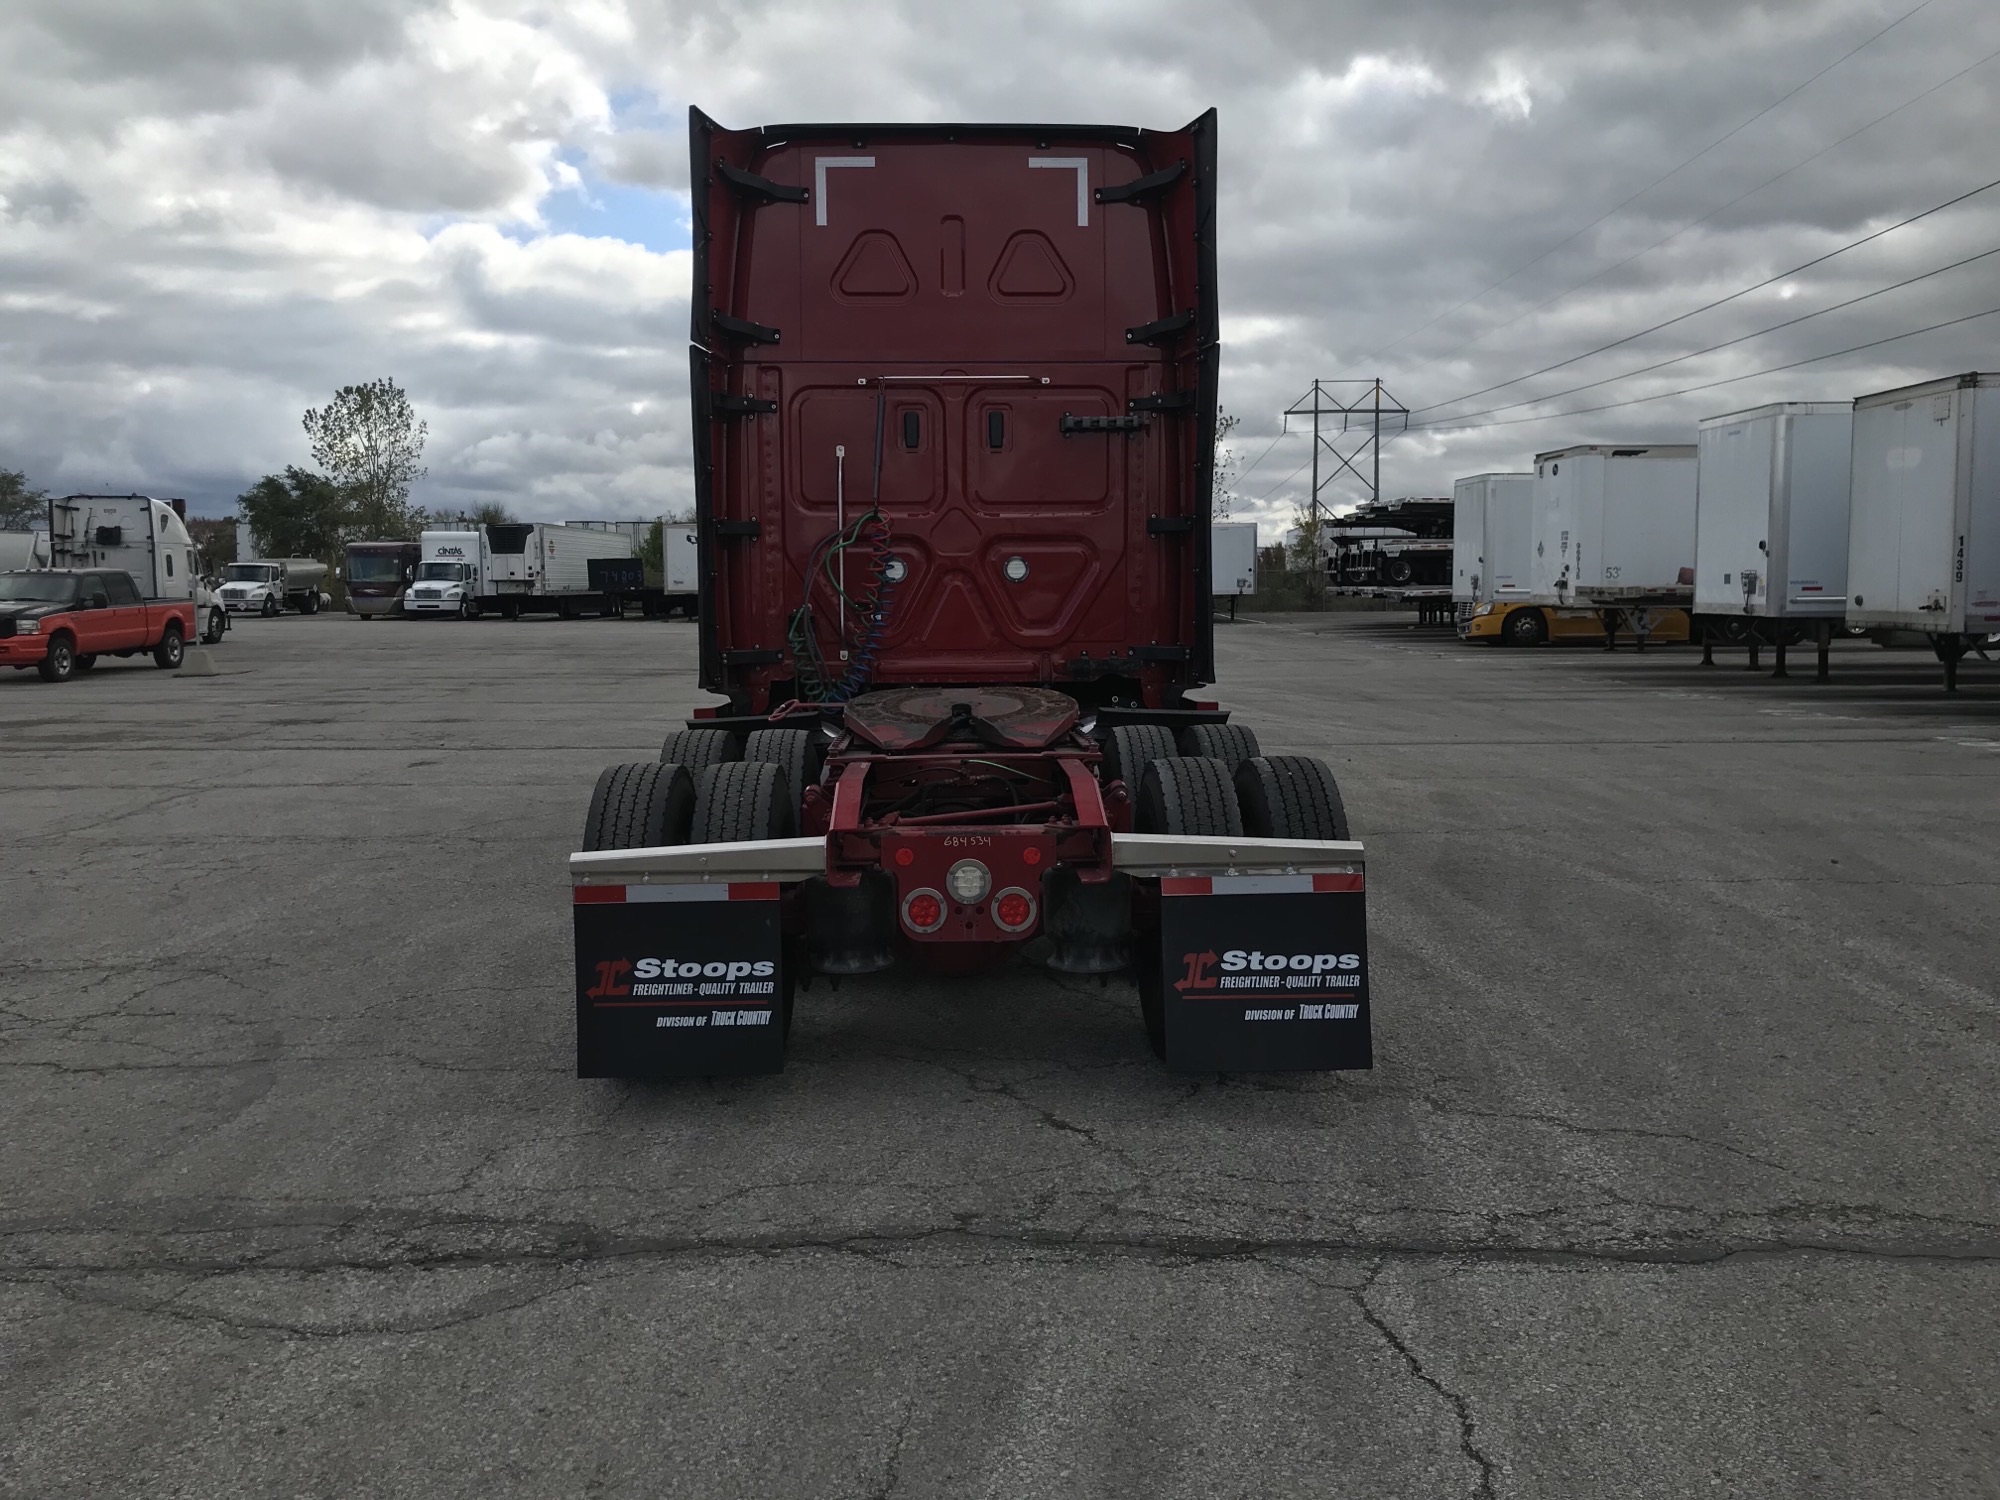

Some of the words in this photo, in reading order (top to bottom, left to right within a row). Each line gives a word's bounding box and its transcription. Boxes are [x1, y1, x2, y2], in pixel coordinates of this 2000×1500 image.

[438, 545, 463, 555] CINTAS
[1955, 535, 1964, 583] 1439
[633, 957, 775, 981] Stoops
[1220, 950, 1360, 974] Stoops
[739, 982, 775, 994] TRAILER
[1325, 975, 1361, 987] TRAILER
[656, 1017, 695, 1028] DIVISION
[696, 1016, 708, 1027] OF
[710, 1010, 736, 1026] TRUCK
[736, 1010, 773, 1026] COUNTRY
[1244, 1009, 1283, 1021] DIVISION
[1284, 1009, 1296, 1020] OF
[1299, 1003, 1324, 1020] TRUCK
[1324, 1003, 1360, 1020] COUNTRY
